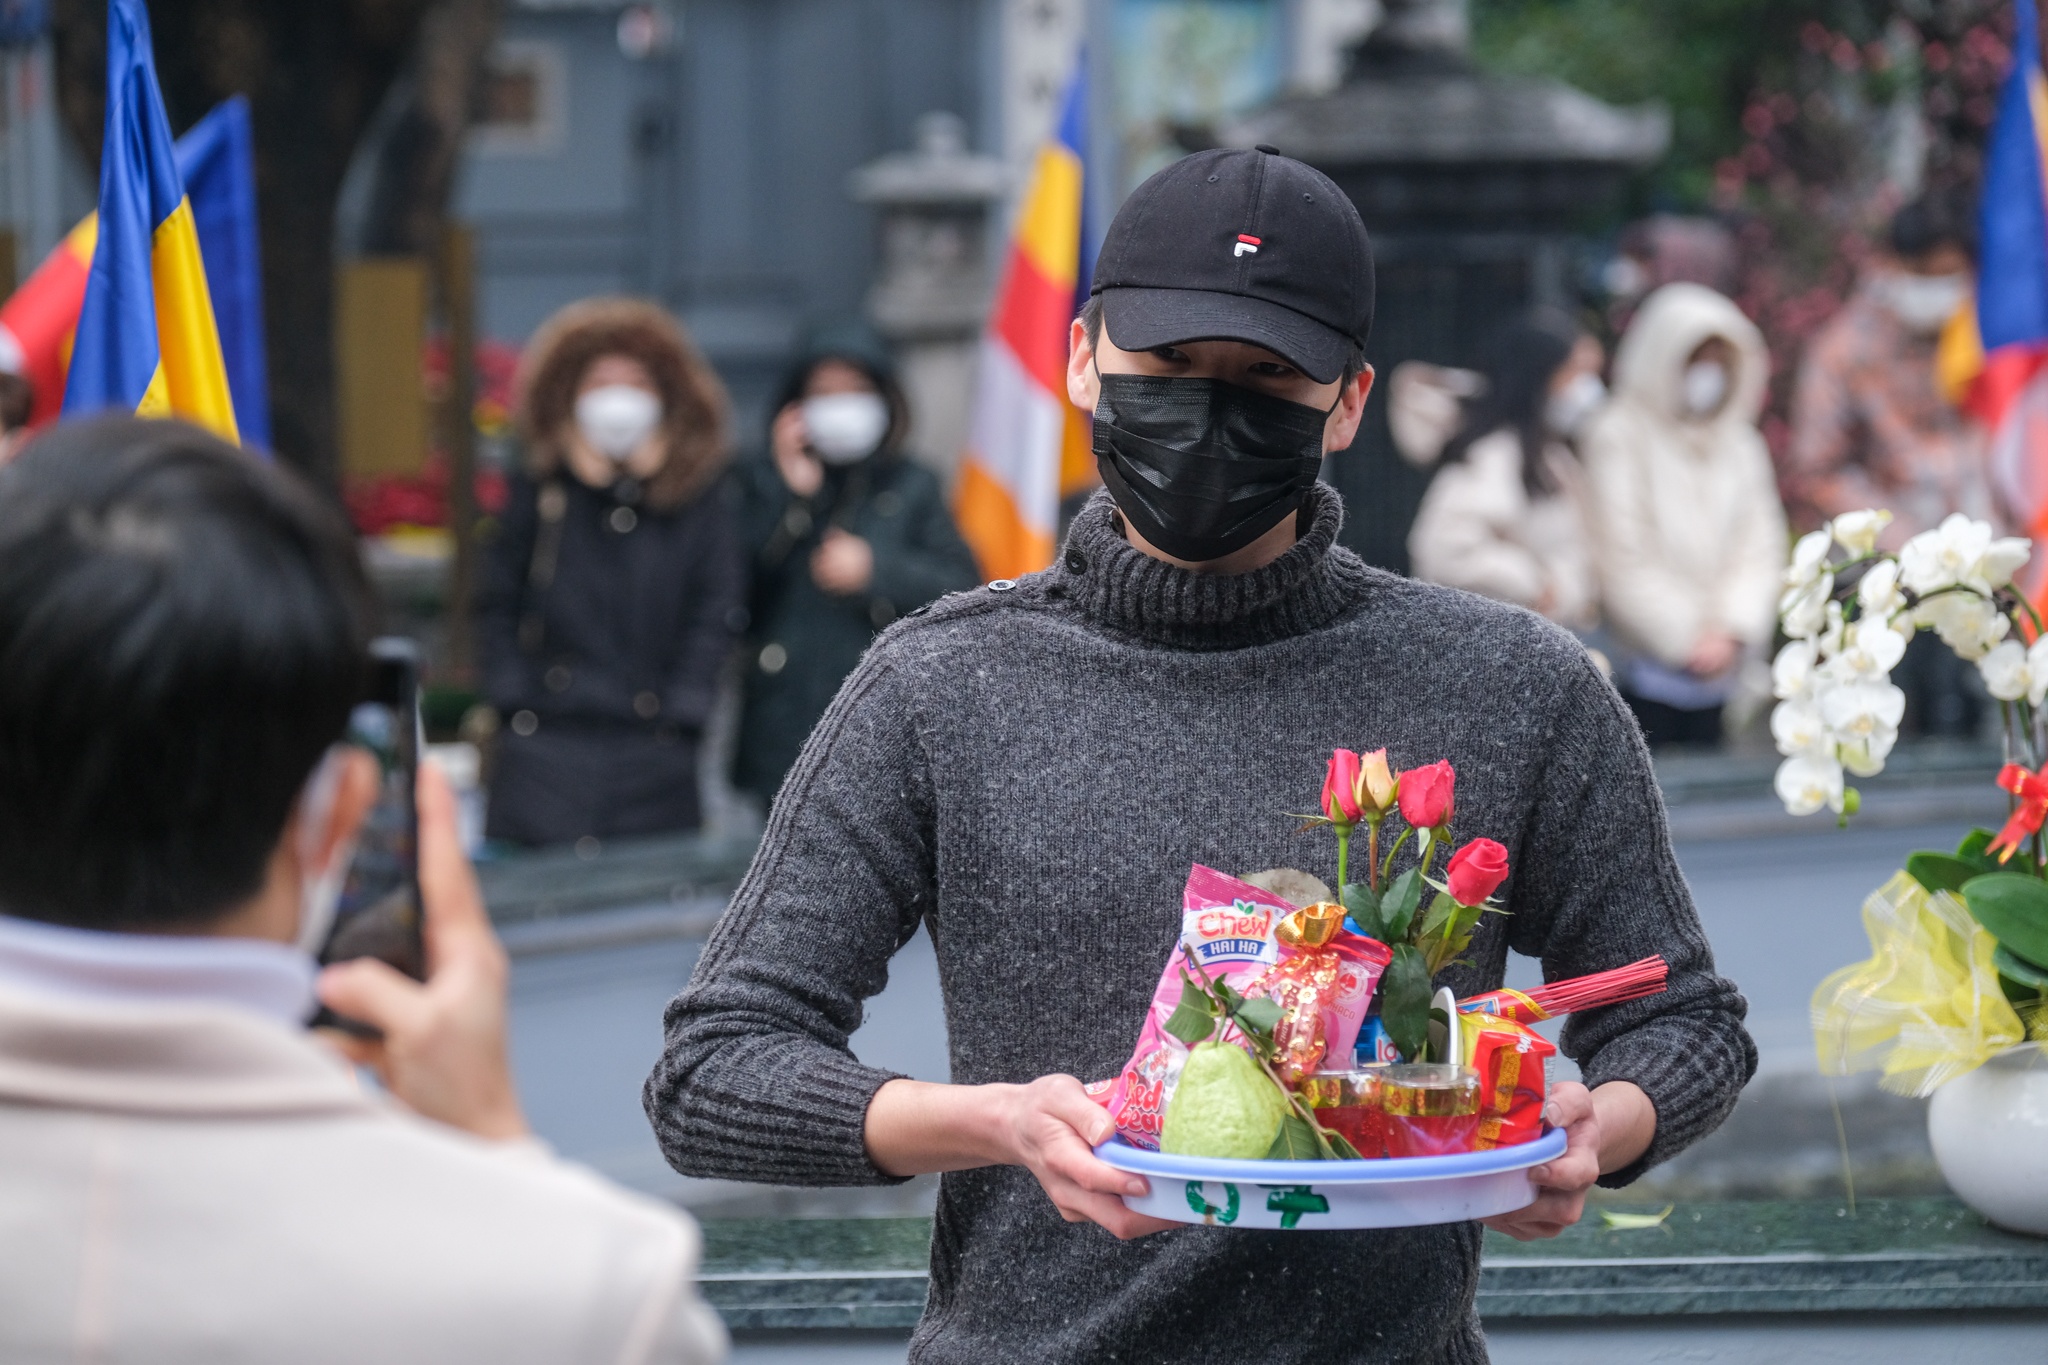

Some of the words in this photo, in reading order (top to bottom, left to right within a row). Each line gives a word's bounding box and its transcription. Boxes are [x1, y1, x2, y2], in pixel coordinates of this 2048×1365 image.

[1197, 910, 1271, 938] Chew
[1210, 940, 1235, 955] HAI
[1238, 940, 1259, 955] HA
